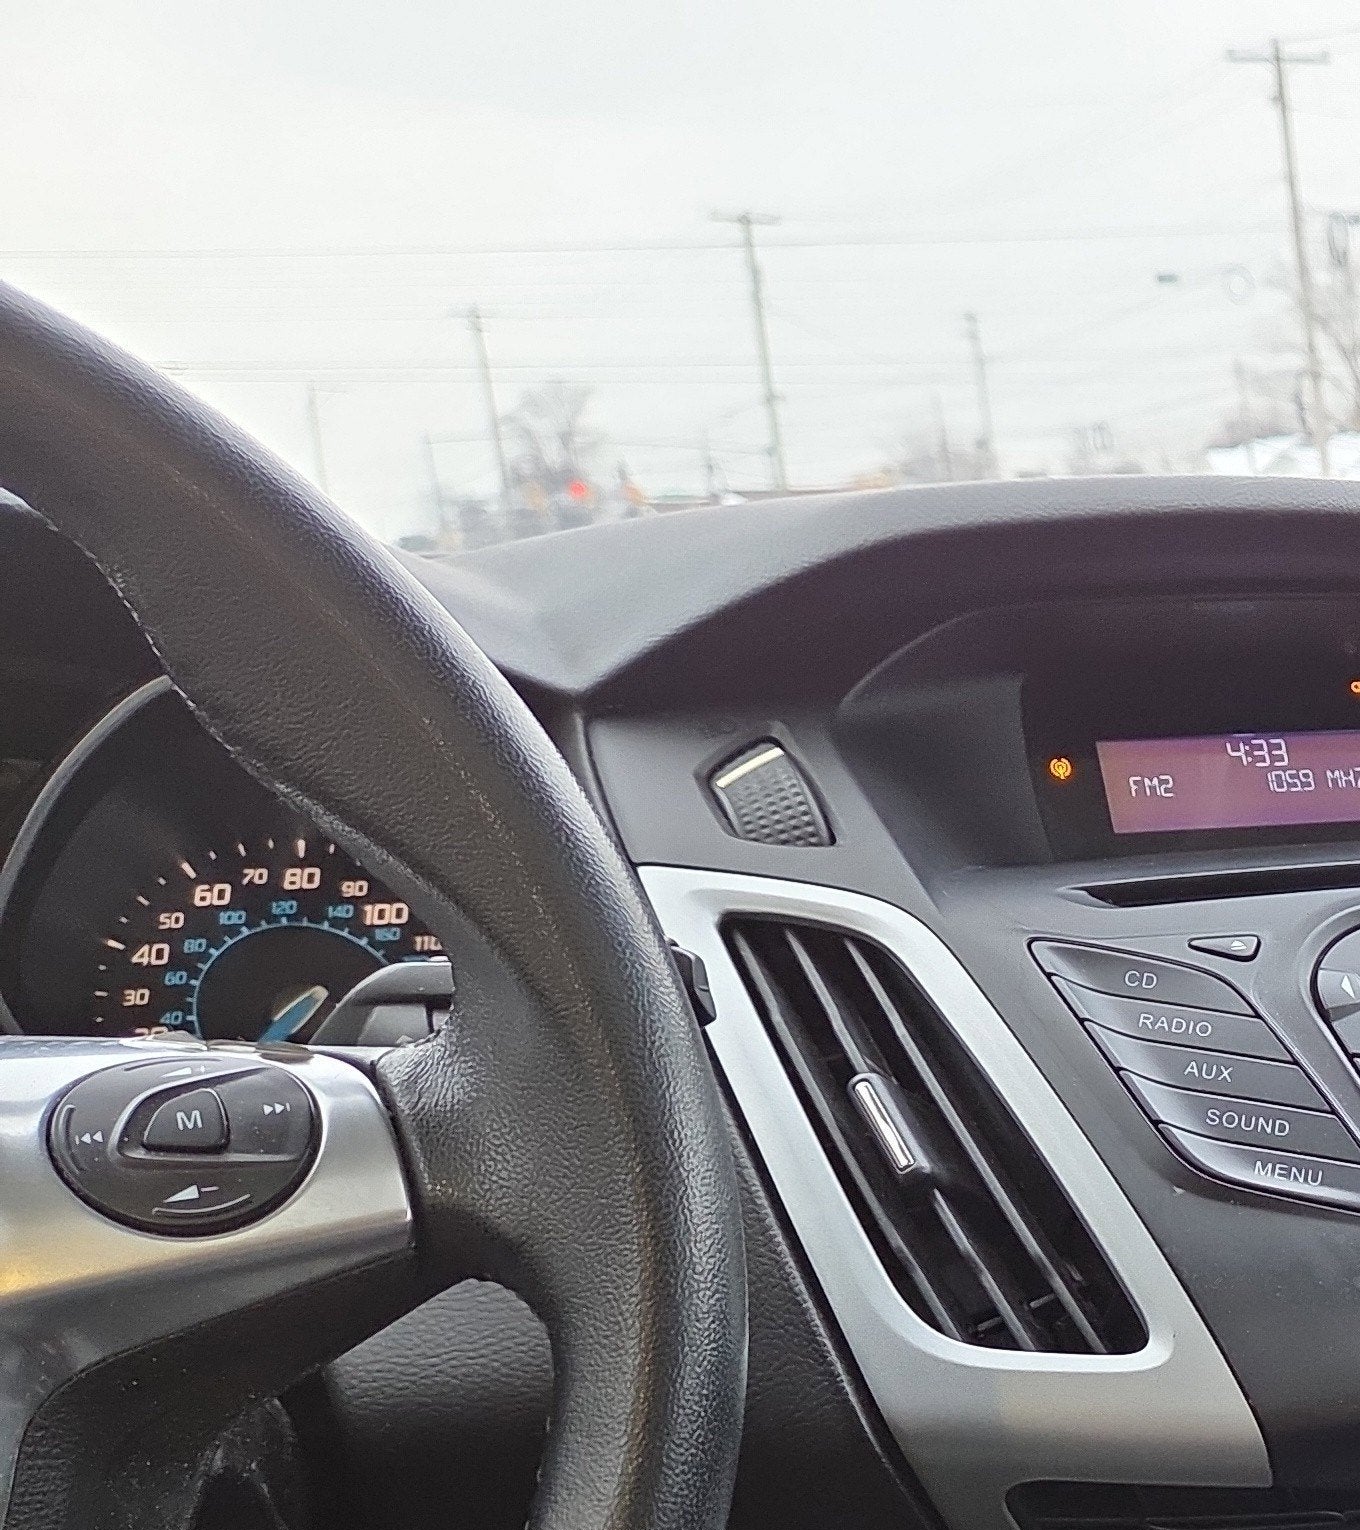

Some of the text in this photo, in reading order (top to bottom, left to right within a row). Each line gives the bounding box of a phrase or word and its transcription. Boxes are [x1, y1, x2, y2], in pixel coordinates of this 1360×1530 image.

[1226, 738, 1289, 767] 4:33
[1129, 775, 1174, 797] FM2
[242, 868, 269, 885] 70
[283, 866, 321, 890] 80
[193, 883, 232, 907] 60
[341, 880, 368, 897] 90
[218, 910, 247, 925] 100
[271, 900, 297, 915] 120
[363, 902, 409, 926] 100
[158, 911, 185, 930] 50
[131, 942, 171, 966] 40
[183, 938, 207, 954] 80
[163, 971, 187, 985] 60
[1124, 970, 1158, 990] CD
[122, 988, 150, 1007] 30
[159, 1011, 183, 1026] 40
[1138, 1013, 1213, 1038] RADIO
[1183, 1060, 1235, 1083] AUX
[175, 1109, 203, 1131] M
[1205, 1108, 1291, 1137] SOUND
[1254, 1159, 1324, 1187] MENU
